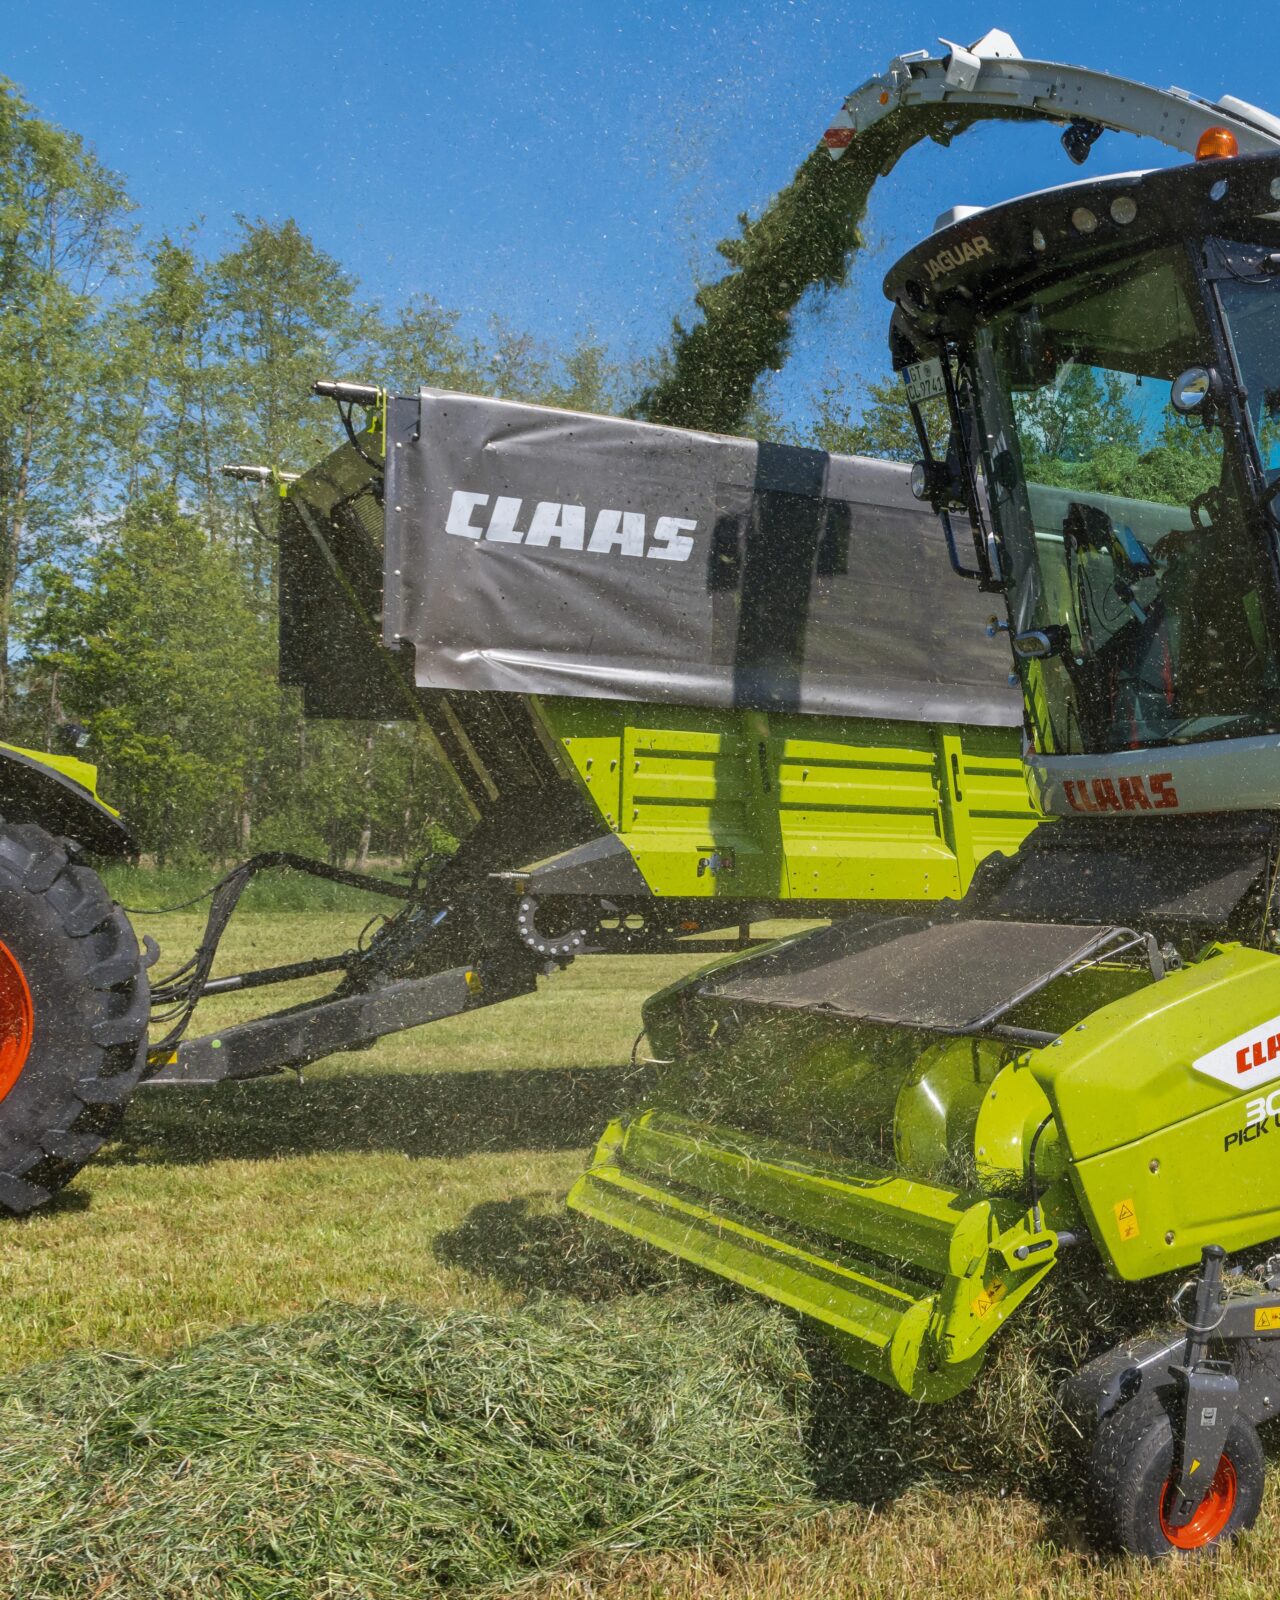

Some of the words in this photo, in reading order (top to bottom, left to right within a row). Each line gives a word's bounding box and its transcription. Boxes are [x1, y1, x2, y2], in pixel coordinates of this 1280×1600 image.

[923, 236, 993, 280] JAGUAR
[909, 365, 922, 383] GT
[445, 490, 698, 562] CLAAS
[1063, 773, 1179, 812] CLAAS
[1224, 1117, 1269, 1152] PICK
